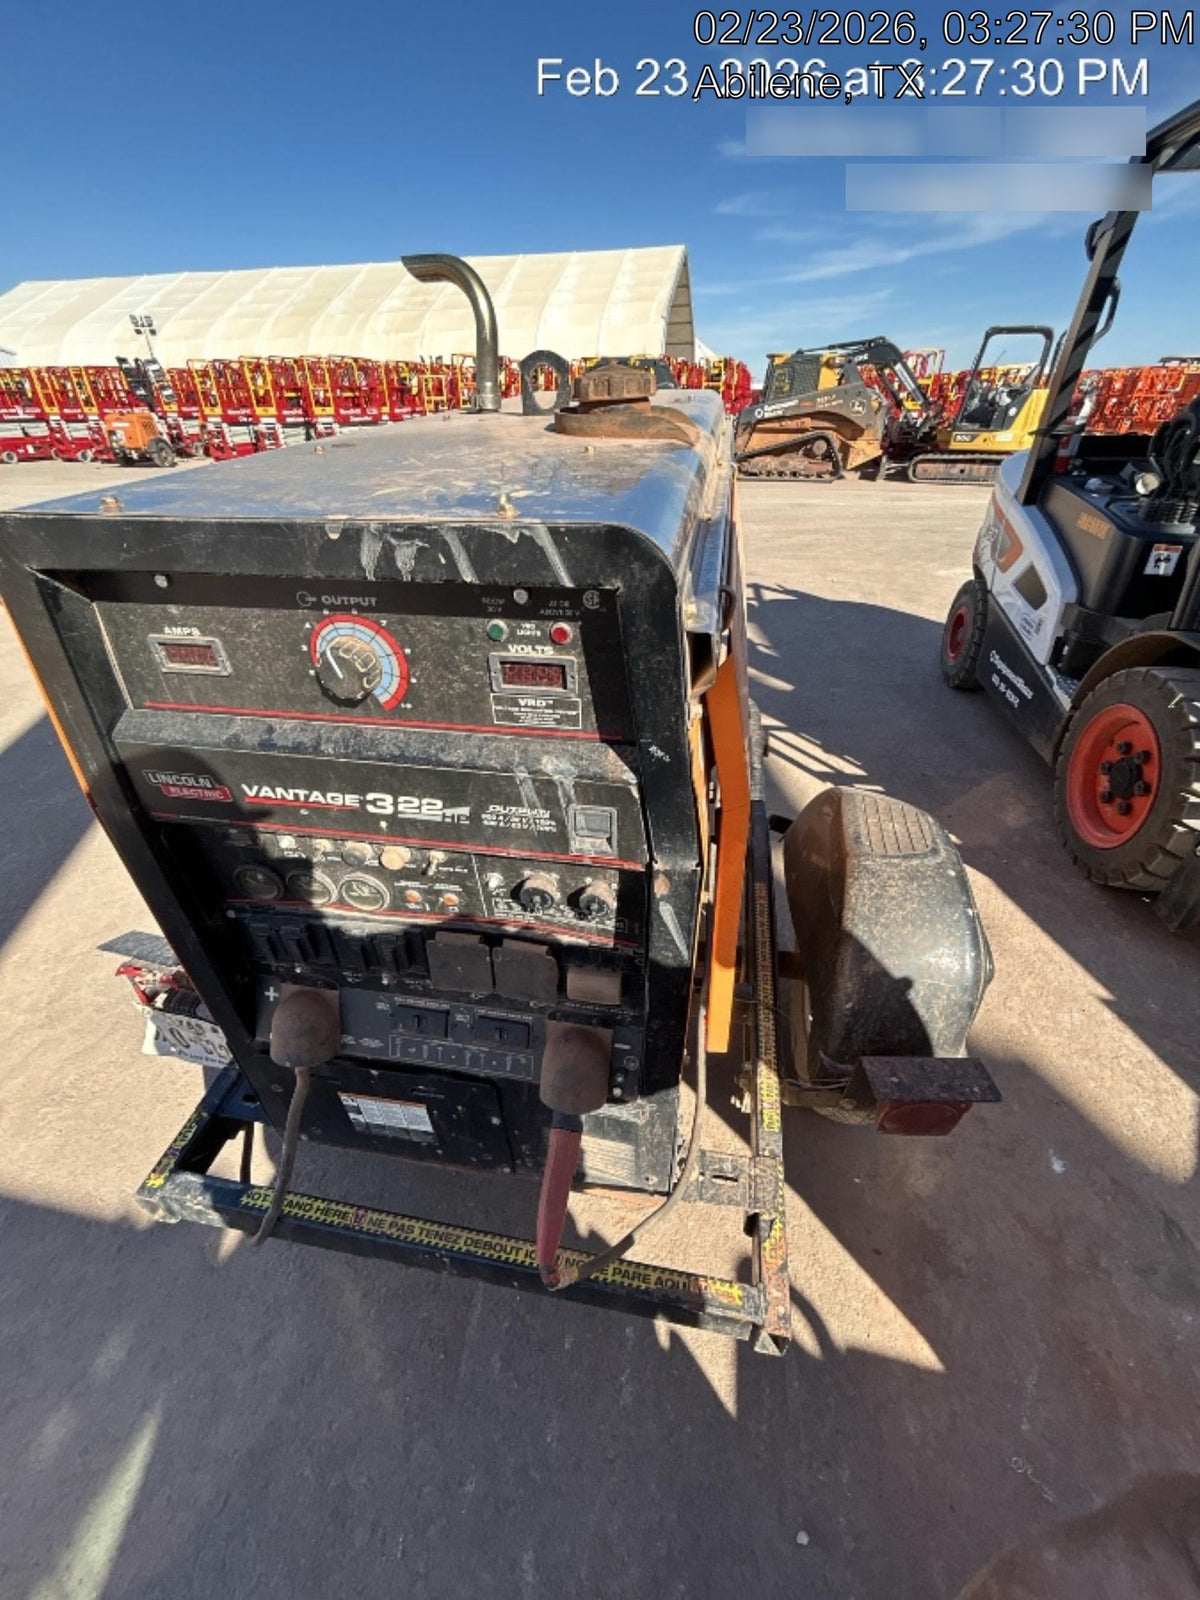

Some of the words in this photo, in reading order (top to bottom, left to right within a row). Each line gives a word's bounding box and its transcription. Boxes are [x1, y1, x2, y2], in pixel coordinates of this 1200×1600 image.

[321, 595, 377, 607] OUTPUT
[164, 625, 201, 636] AMPS
[507, 644, 554, 656] VOLTS
[148, 772, 213, 789] LINCOLN
[169, 786, 226, 800] ELECTRIC
[241, 783, 361, 808] VANTAGE
[365, 792, 443, 815] 322
[314, 1206, 350, 1222] HERE
[367, 1216, 388, 1230] NE
[389, 1221, 415, 1236] PAS
[419, 1226, 462, 1244] TENEZ
[463, 1236, 524, 1256] DEBOUT
[612, 1266, 652, 1285] PARE
